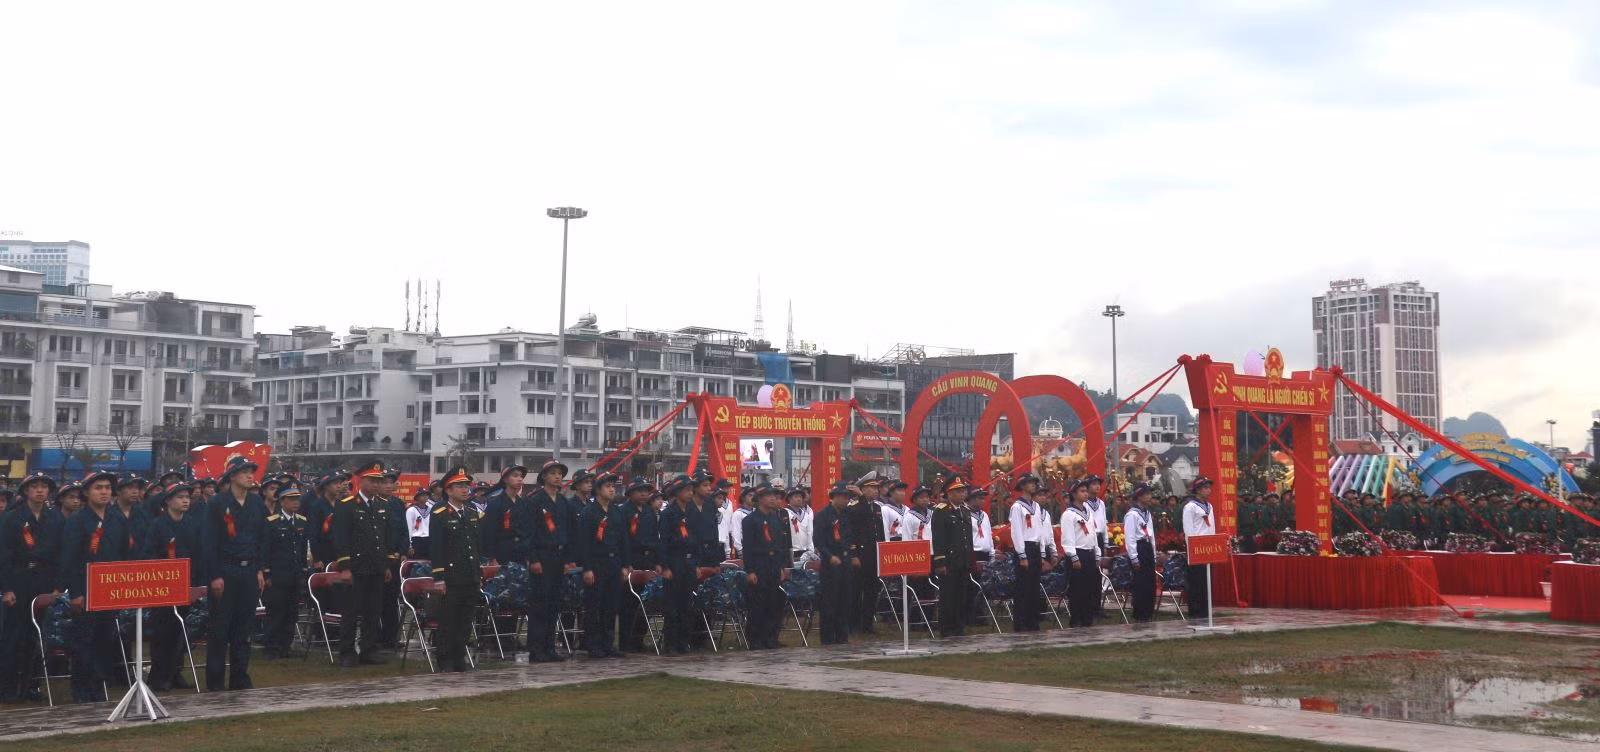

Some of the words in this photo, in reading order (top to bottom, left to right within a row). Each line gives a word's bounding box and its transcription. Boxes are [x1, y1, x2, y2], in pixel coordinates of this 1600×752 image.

[949, 376, 969, 389] VINH
[970, 375, 998, 393] QUANG
[1247, 386, 1265, 404] QUANG
[1266, 386, 1274, 404] LÀ
[735, 411, 751, 429] TIẾP
[752, 413, 773, 430] BƯỚC
[1194, 544, 1205, 555] HẢI
[1205, 543, 1222, 555] QUÂN
[883, 552, 893, 564] SƯ
[893, 551, 914, 564] ĐOÀN
[915, 552, 926, 562] 365
[99, 572, 134, 584] TRUNG
[136, 569, 164, 582] ĐOÀN
[165, 570, 180, 580] 213
[109, 588, 123, 600] SƯ
[125, 586, 153, 599] ĐOÀN
[154, 587, 170, 597] 363
